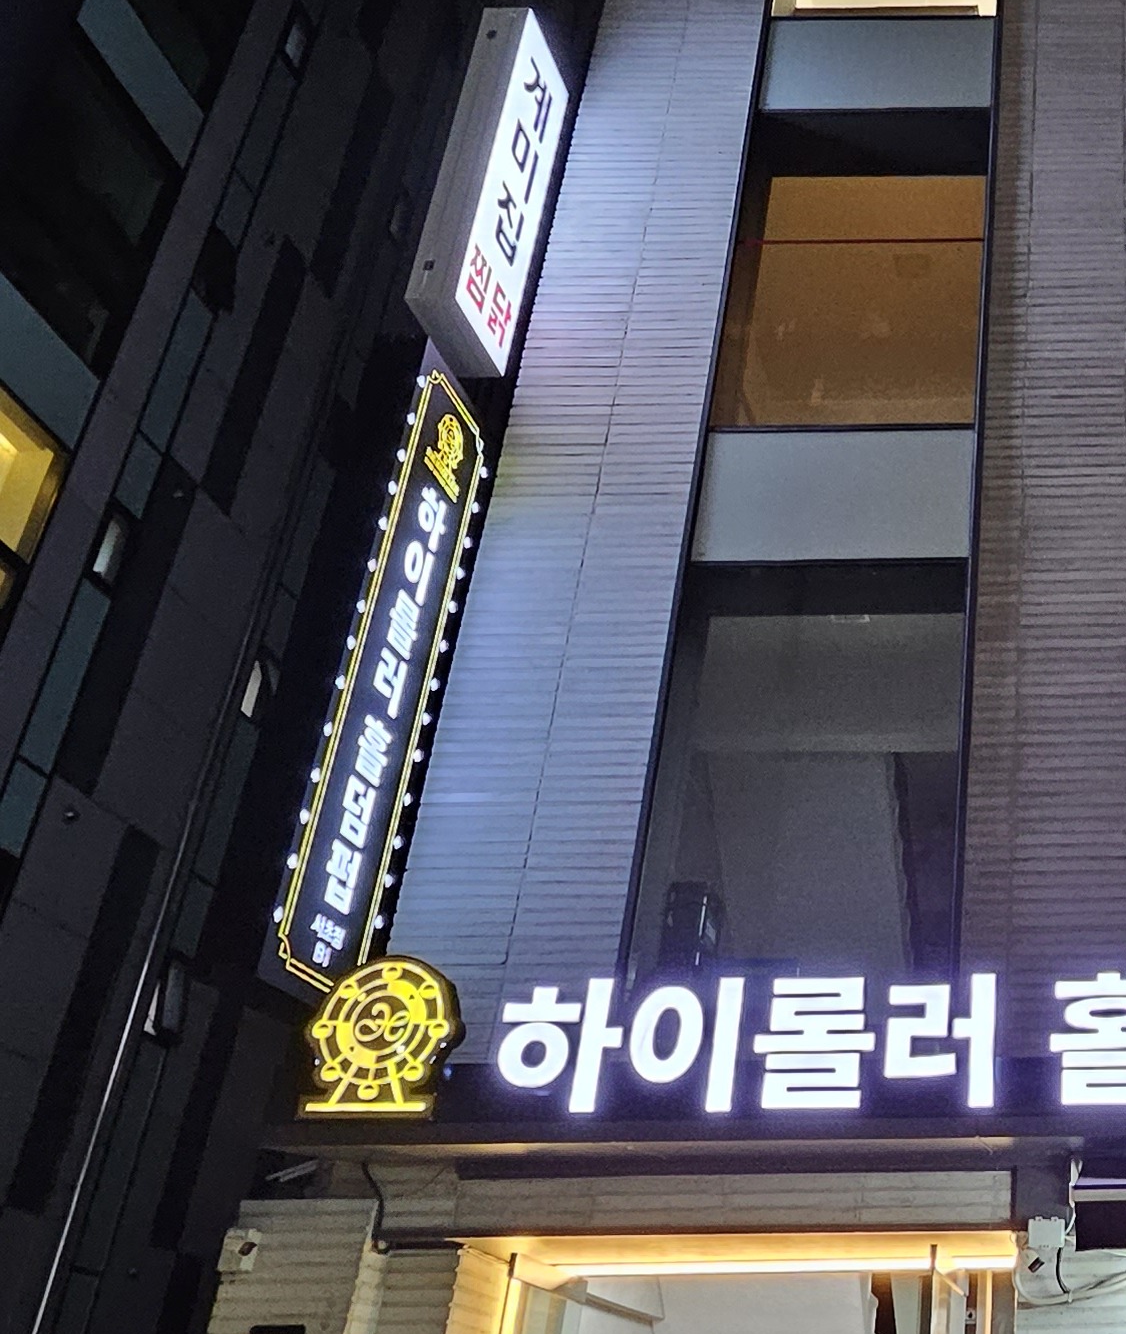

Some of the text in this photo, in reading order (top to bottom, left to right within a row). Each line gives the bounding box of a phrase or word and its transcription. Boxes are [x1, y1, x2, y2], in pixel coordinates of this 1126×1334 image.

[496, 56, 553, 267] 계미집
[466, 243, 513, 348] 찜닭
[373, 486, 448, 720] 하이롤러
[324, 714, 393, 916] 홀덤펍
[496, 972, 999, 1114] 하이롤러
